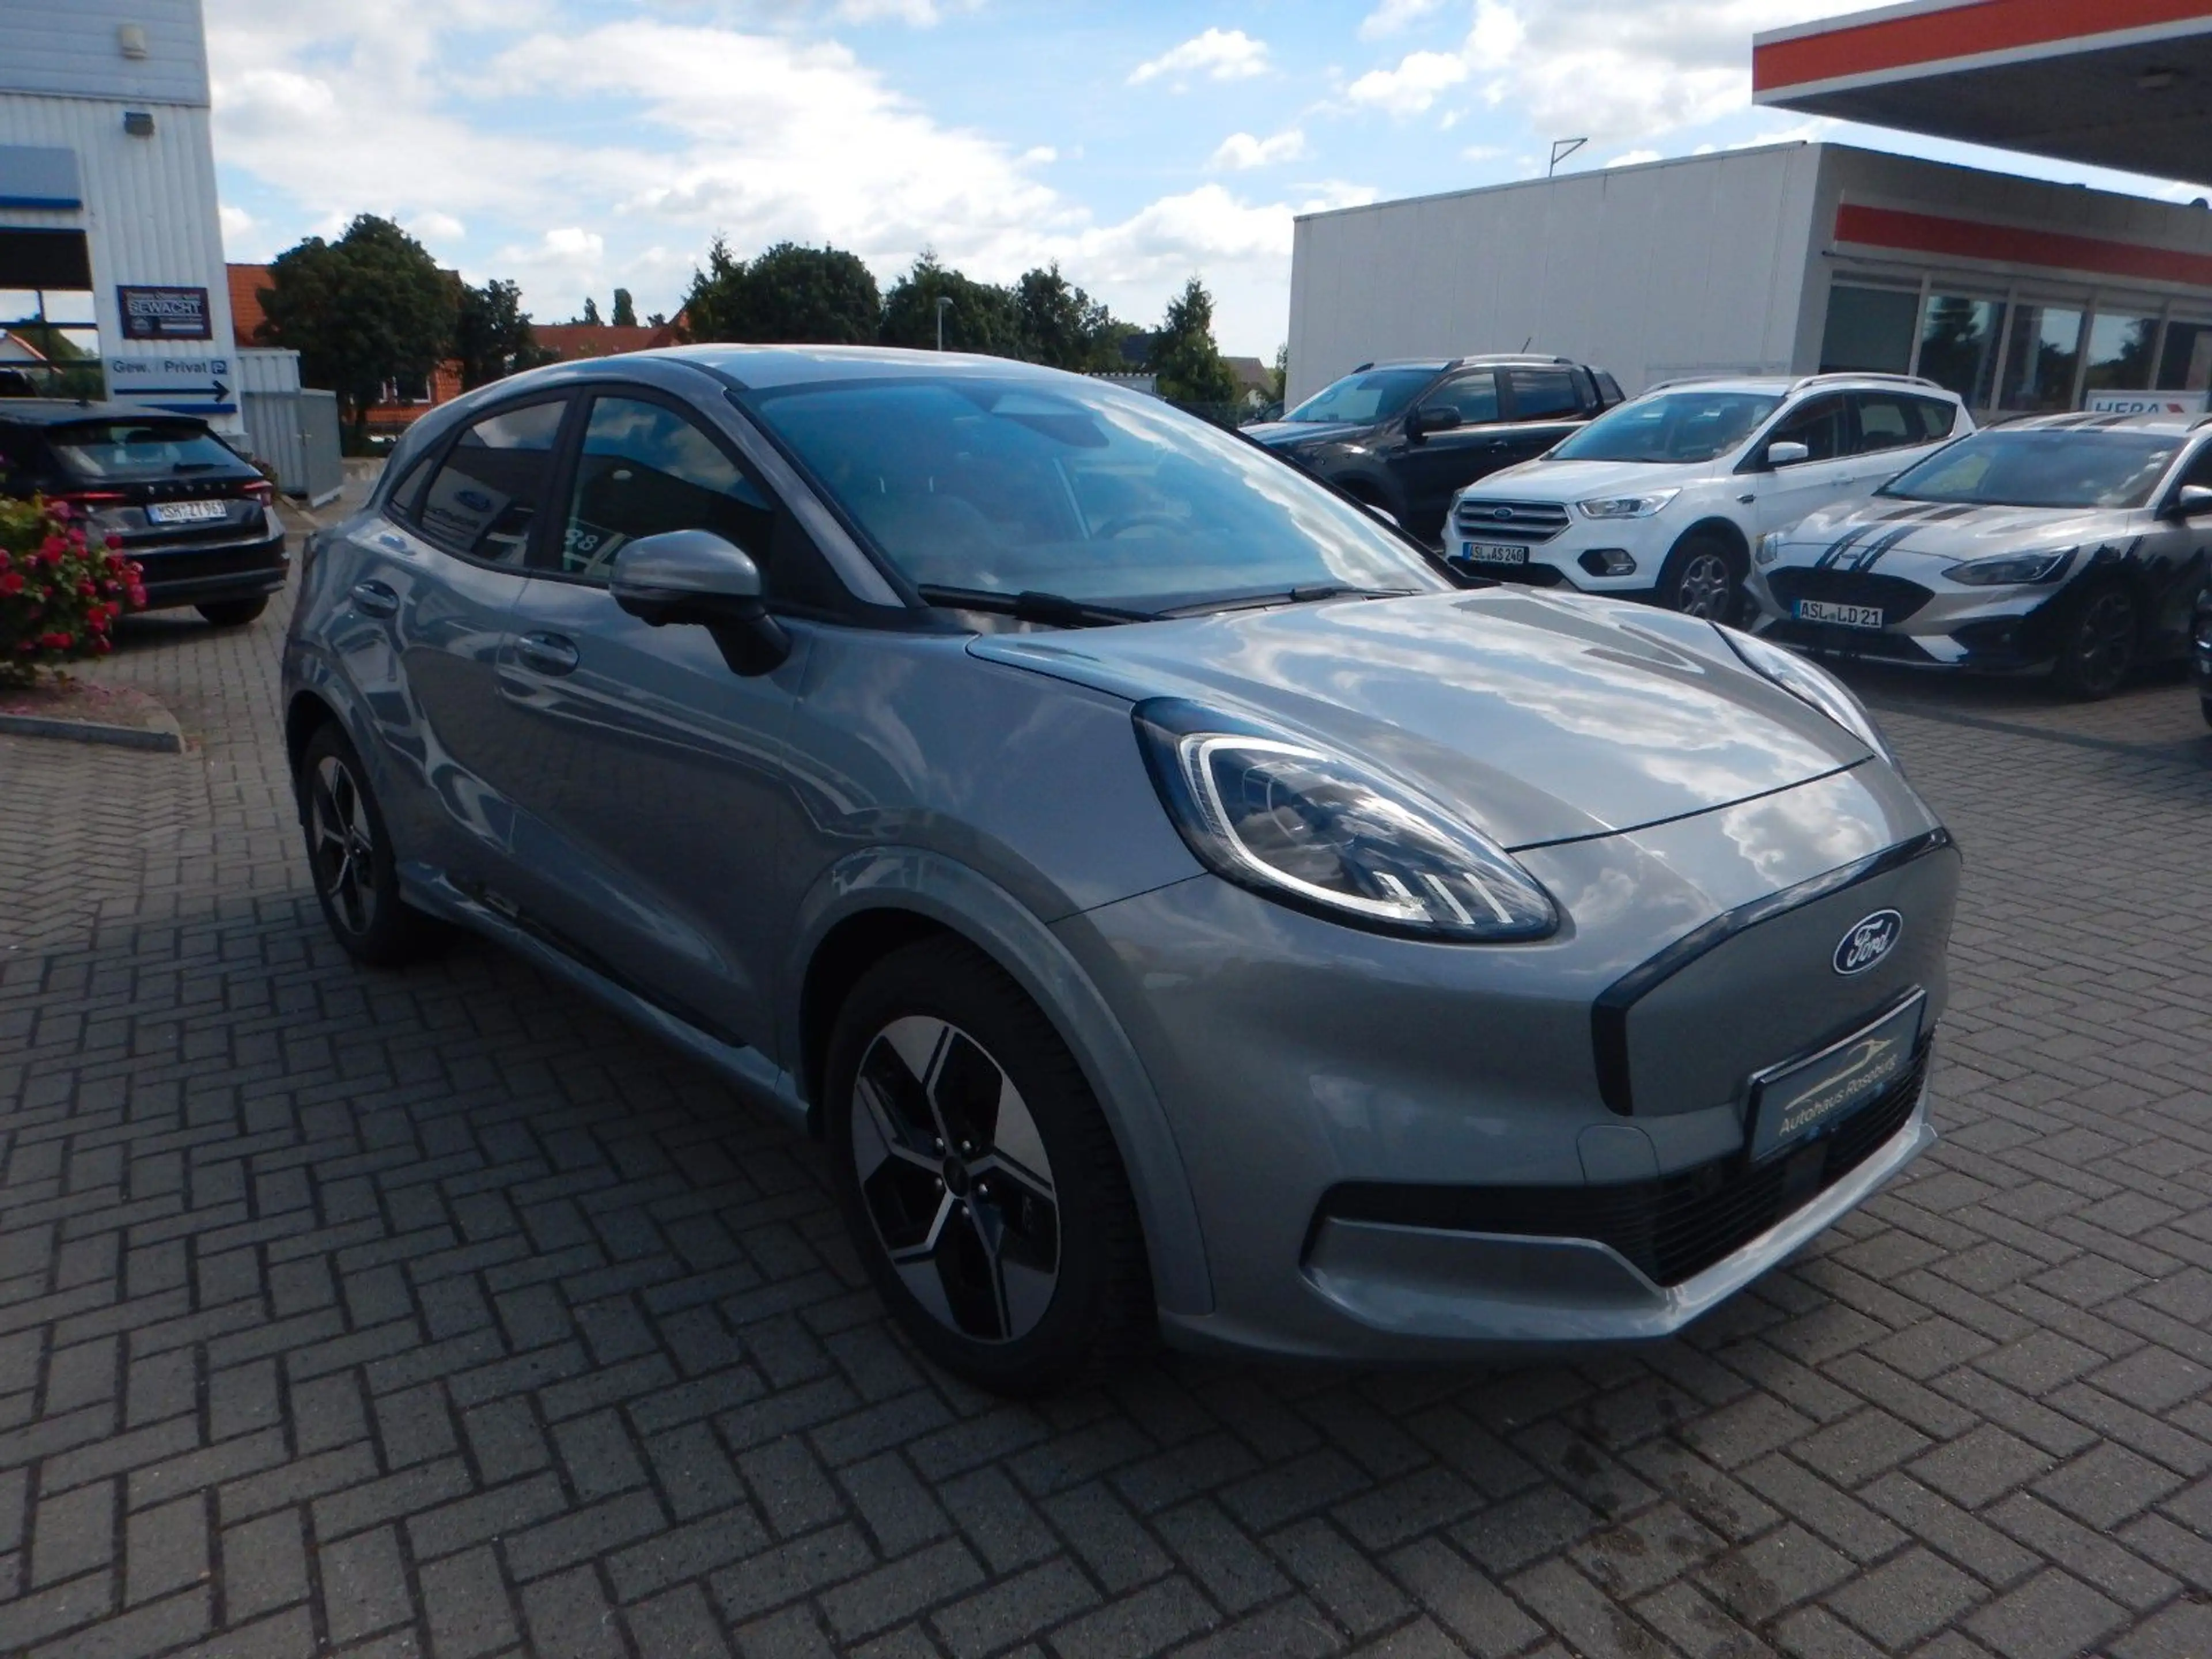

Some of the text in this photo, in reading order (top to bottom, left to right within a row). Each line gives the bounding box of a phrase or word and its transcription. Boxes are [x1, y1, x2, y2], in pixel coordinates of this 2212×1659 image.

[164, 359, 208, 373] Privat
[1801, 602, 1879, 625] ASL LD 21
[1847, 919, 1893, 967] Ford
[1779, 1089, 1844, 1137] Autohaus
